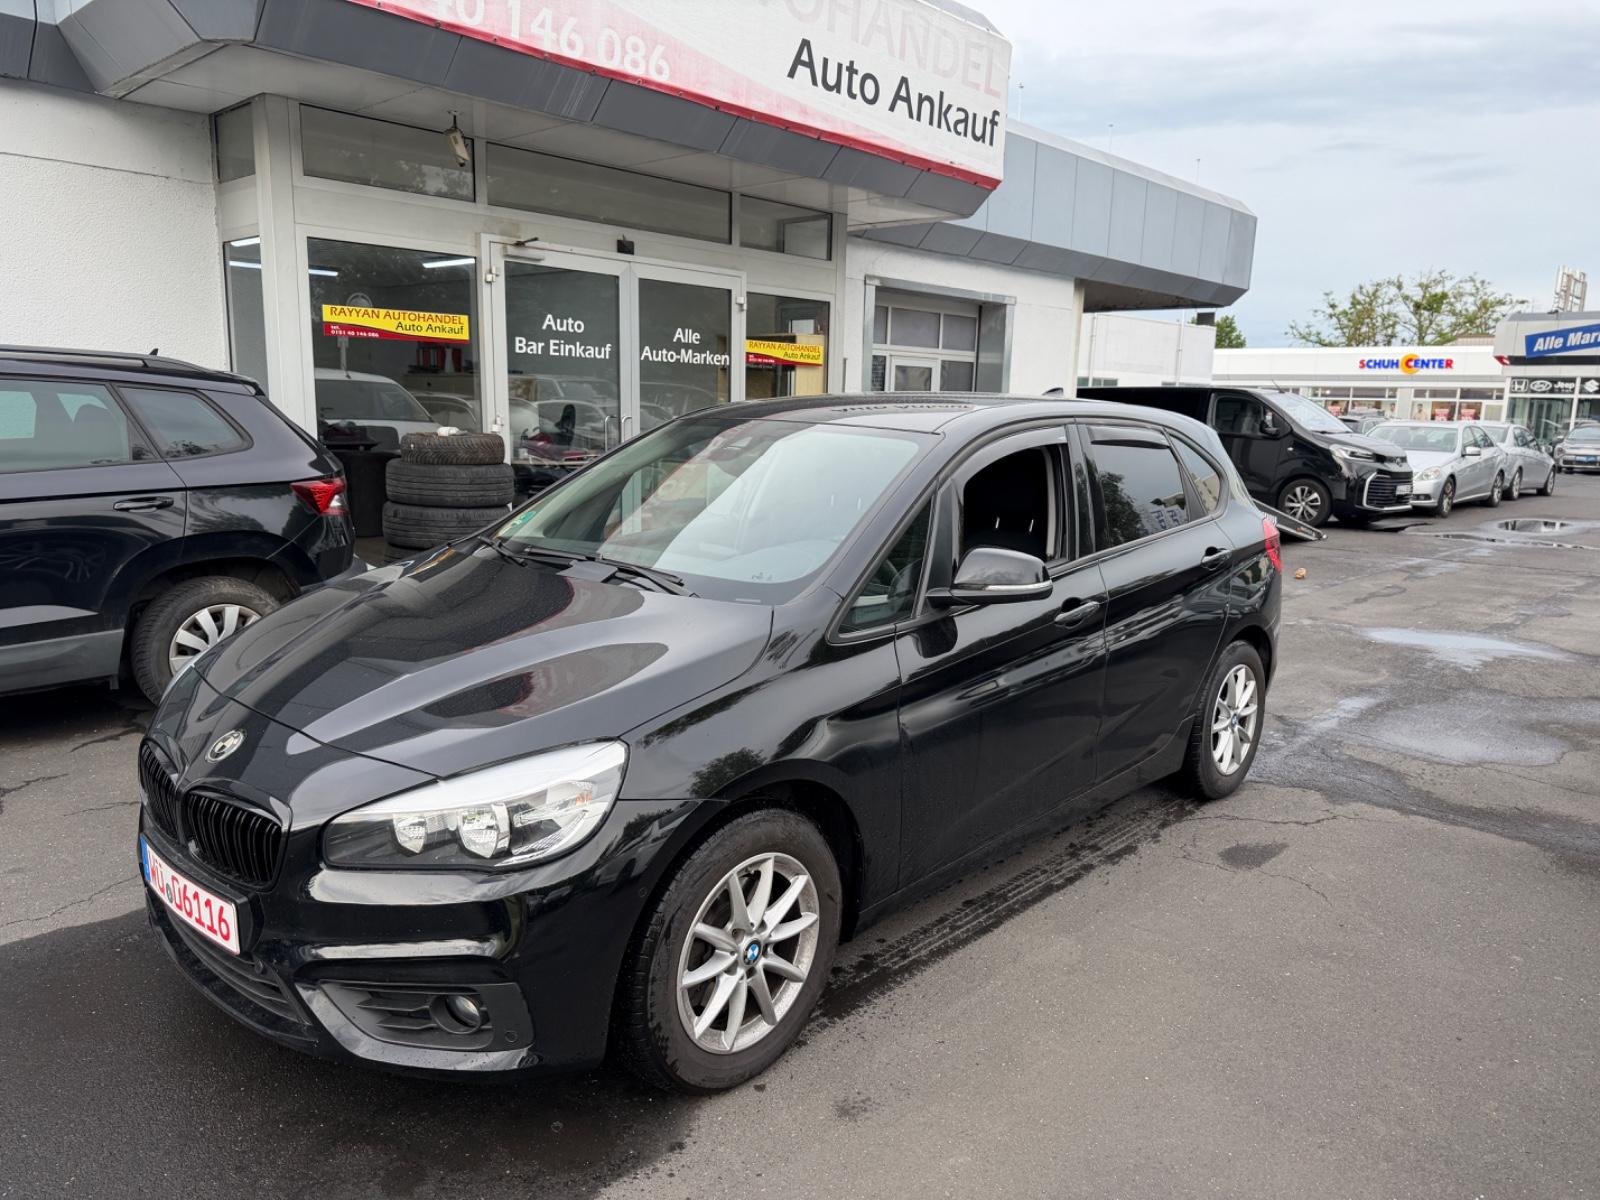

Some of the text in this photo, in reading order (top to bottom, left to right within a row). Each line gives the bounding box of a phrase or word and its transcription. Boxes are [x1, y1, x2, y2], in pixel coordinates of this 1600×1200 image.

[507, 0, 584, 57] 146
[602, 28, 671, 81] 086
[787, 38, 1000, 146] Auto Ankauf
[330, 306, 464, 325] RAYYAN AUTOHANDEL
[542, 314, 585, 333] Auto
[395, 321, 464, 335] Auto Ankauf
[673, 328, 701, 344] Alle
[515, 336, 612, 360] Bar Einkauf
[1533, 331, 1600, 352] Alle Mar
[641, 346, 730, 367] Auto-Marken
[783, 351, 798, 359] Auto
[1359, 358, 1453, 369] SCHUH CENTER
[1554, 381, 1575, 390] Jeep
